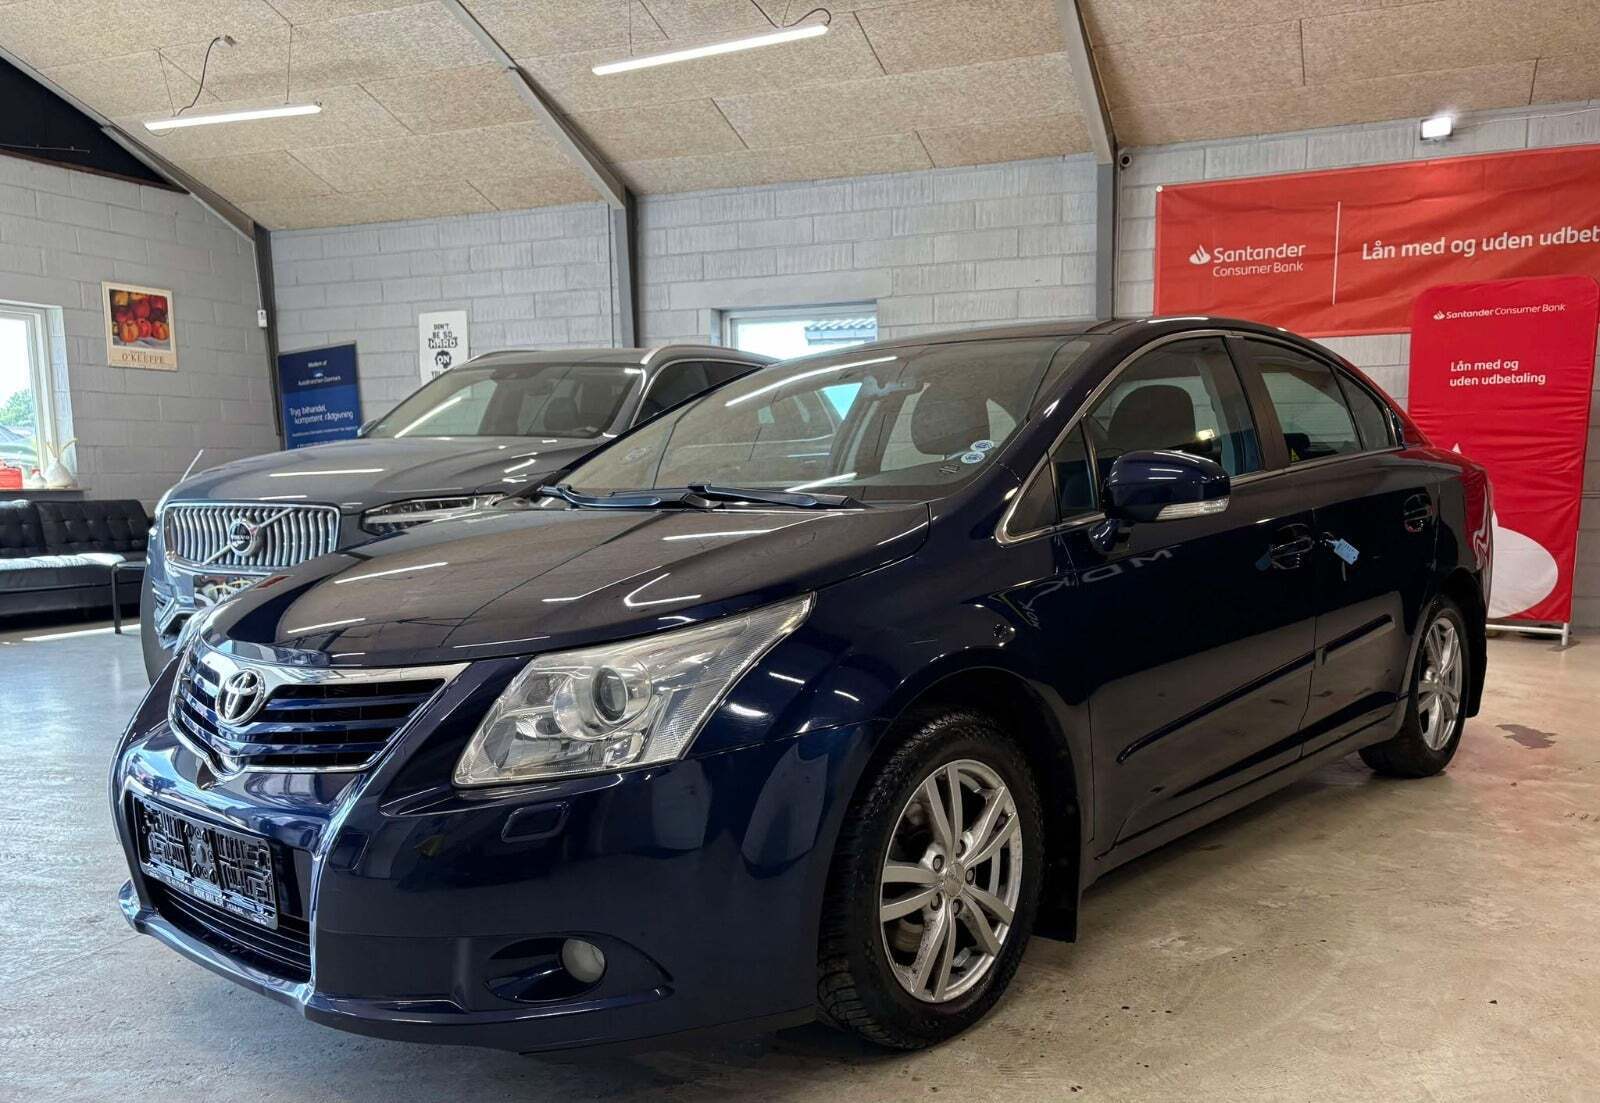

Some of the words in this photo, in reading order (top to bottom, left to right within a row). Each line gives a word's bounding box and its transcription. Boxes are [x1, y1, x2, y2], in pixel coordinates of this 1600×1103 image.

[1361, 240, 1396, 261] Lån
[1401, 237, 1446, 257] med
[1450, 238, 1476, 257] og
[1481, 232, 1534, 252] uden
[1539, 226, 1600, 246] udbet
[1213, 243, 1307, 263] Santander
[1212, 264, 1273, 278] Consumer
[1274, 261, 1304, 274] Bank
[1446, 308, 1495, 320] Santander
[1494, 305, 1542, 317] Consumer
[1542, 303, 1566, 313] Bank
[428, 336, 458, 349] HARD
[432, 331, 440, 339] BE
[443, 331, 453, 339] SO
[1450, 360, 1472, 372] Lån
[1474, 359, 1501, 370] med
[1503, 360, 1519, 371] og
[1449, 376, 1479, 387] uden
[1481, 372, 1546, 385] udbetaling
[294, 414, 323, 425] kompetent
[324, 411, 354, 422] rådgivning
